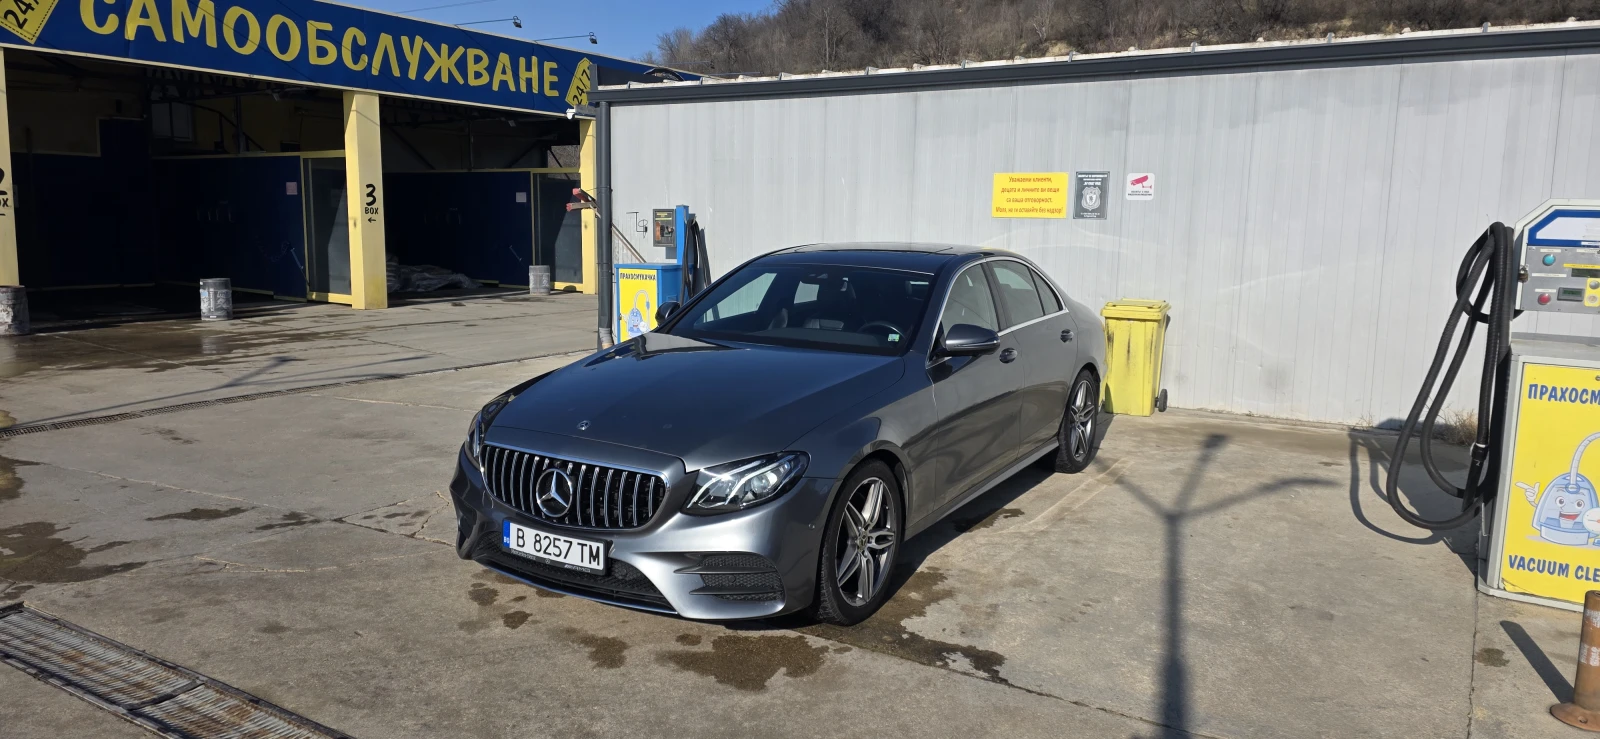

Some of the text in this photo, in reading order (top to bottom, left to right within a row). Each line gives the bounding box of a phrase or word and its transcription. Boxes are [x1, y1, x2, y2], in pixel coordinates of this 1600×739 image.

[3, 0, 39, 30] 24
[79, 0, 560, 96] САМООБСЛУЖВАНЕ
[365, 183, 377, 207] 3
[364, 206, 379, 215] BOX
[516, 528, 600, 566] B 8257 TM
[1508, 555, 1570, 578] VACUUM
